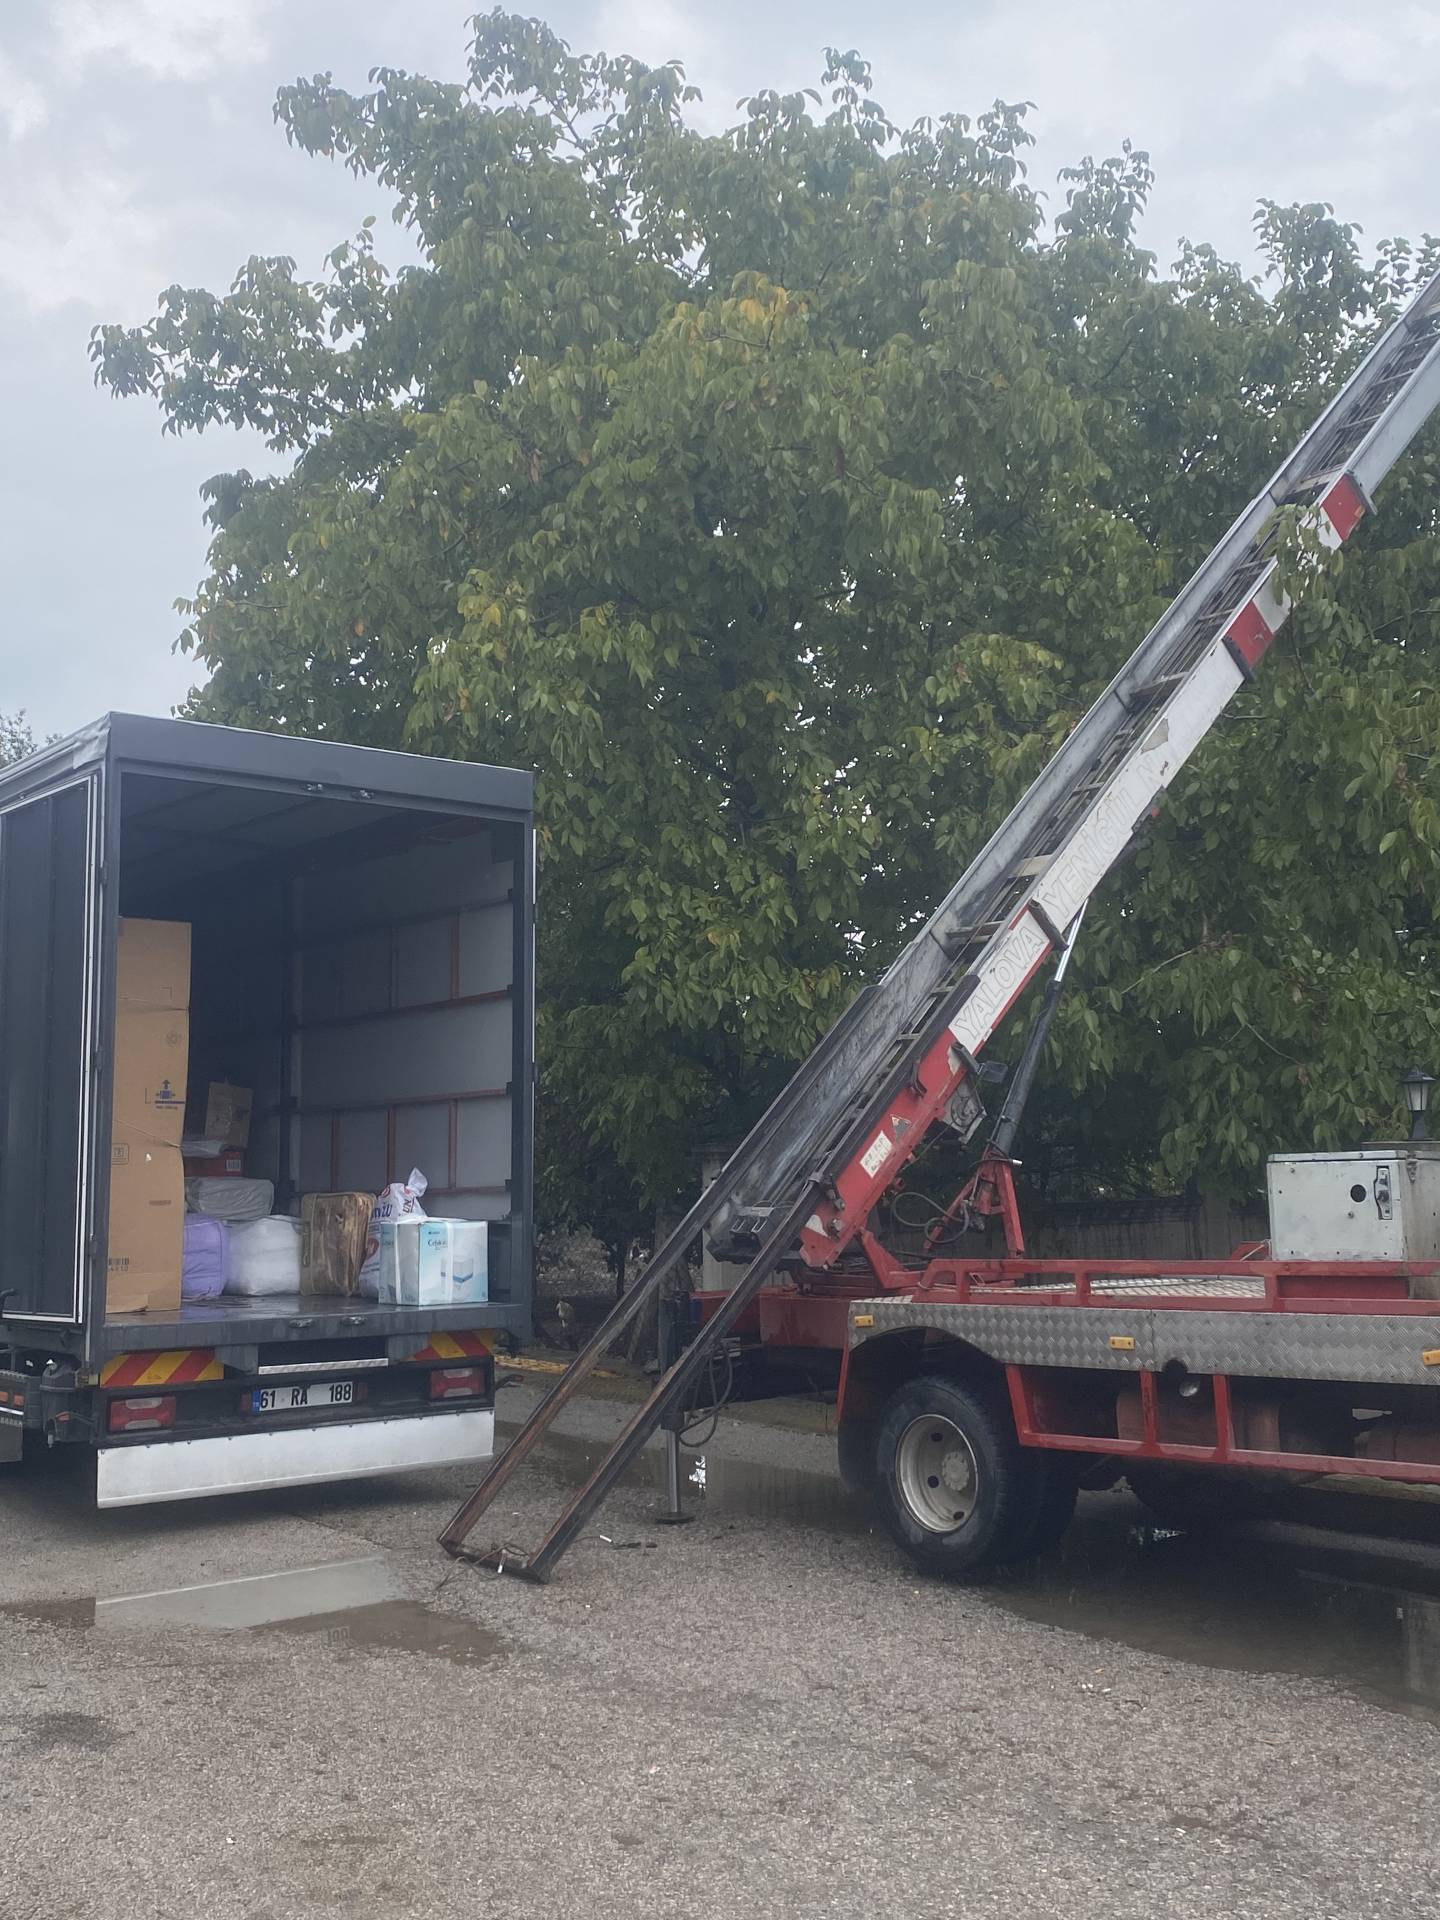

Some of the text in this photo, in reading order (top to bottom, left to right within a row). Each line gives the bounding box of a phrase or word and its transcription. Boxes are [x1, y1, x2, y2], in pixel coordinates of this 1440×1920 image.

[952, 923, 1046, 1042] YALOVA
[260, 1390, 276, 1408] 61
[329, 1383, 352, 1402] 188
